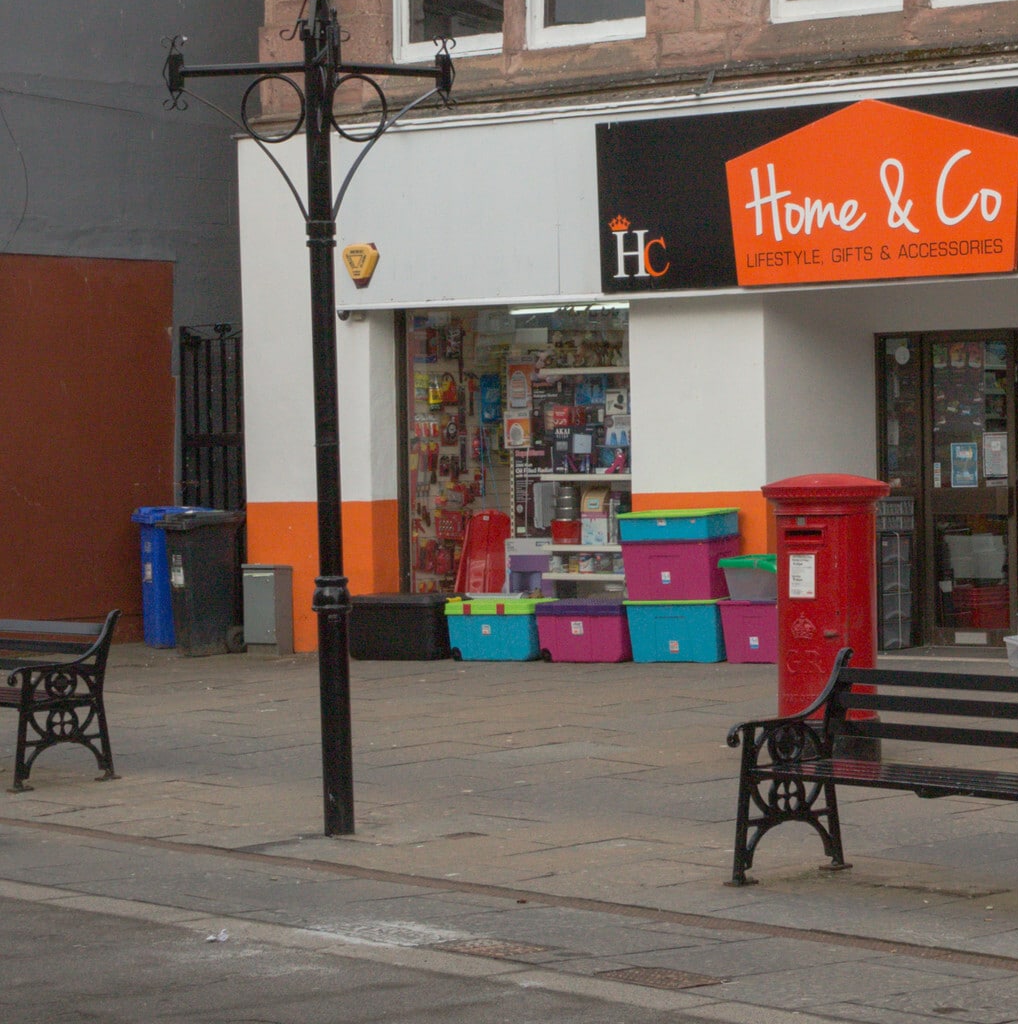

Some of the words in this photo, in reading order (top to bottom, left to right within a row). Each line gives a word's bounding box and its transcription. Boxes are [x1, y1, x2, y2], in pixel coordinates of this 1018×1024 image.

[745, 162, 867, 243] Home
[879, 158, 920, 234] &
[936, 149, 1003, 226] Co
[746, 249, 824, 269] LIFESTYLE,
[831, 245, 874, 264] GIFTS
[879, 245, 892, 261] &
[899, 238, 1004, 260] ACCESSORIES
